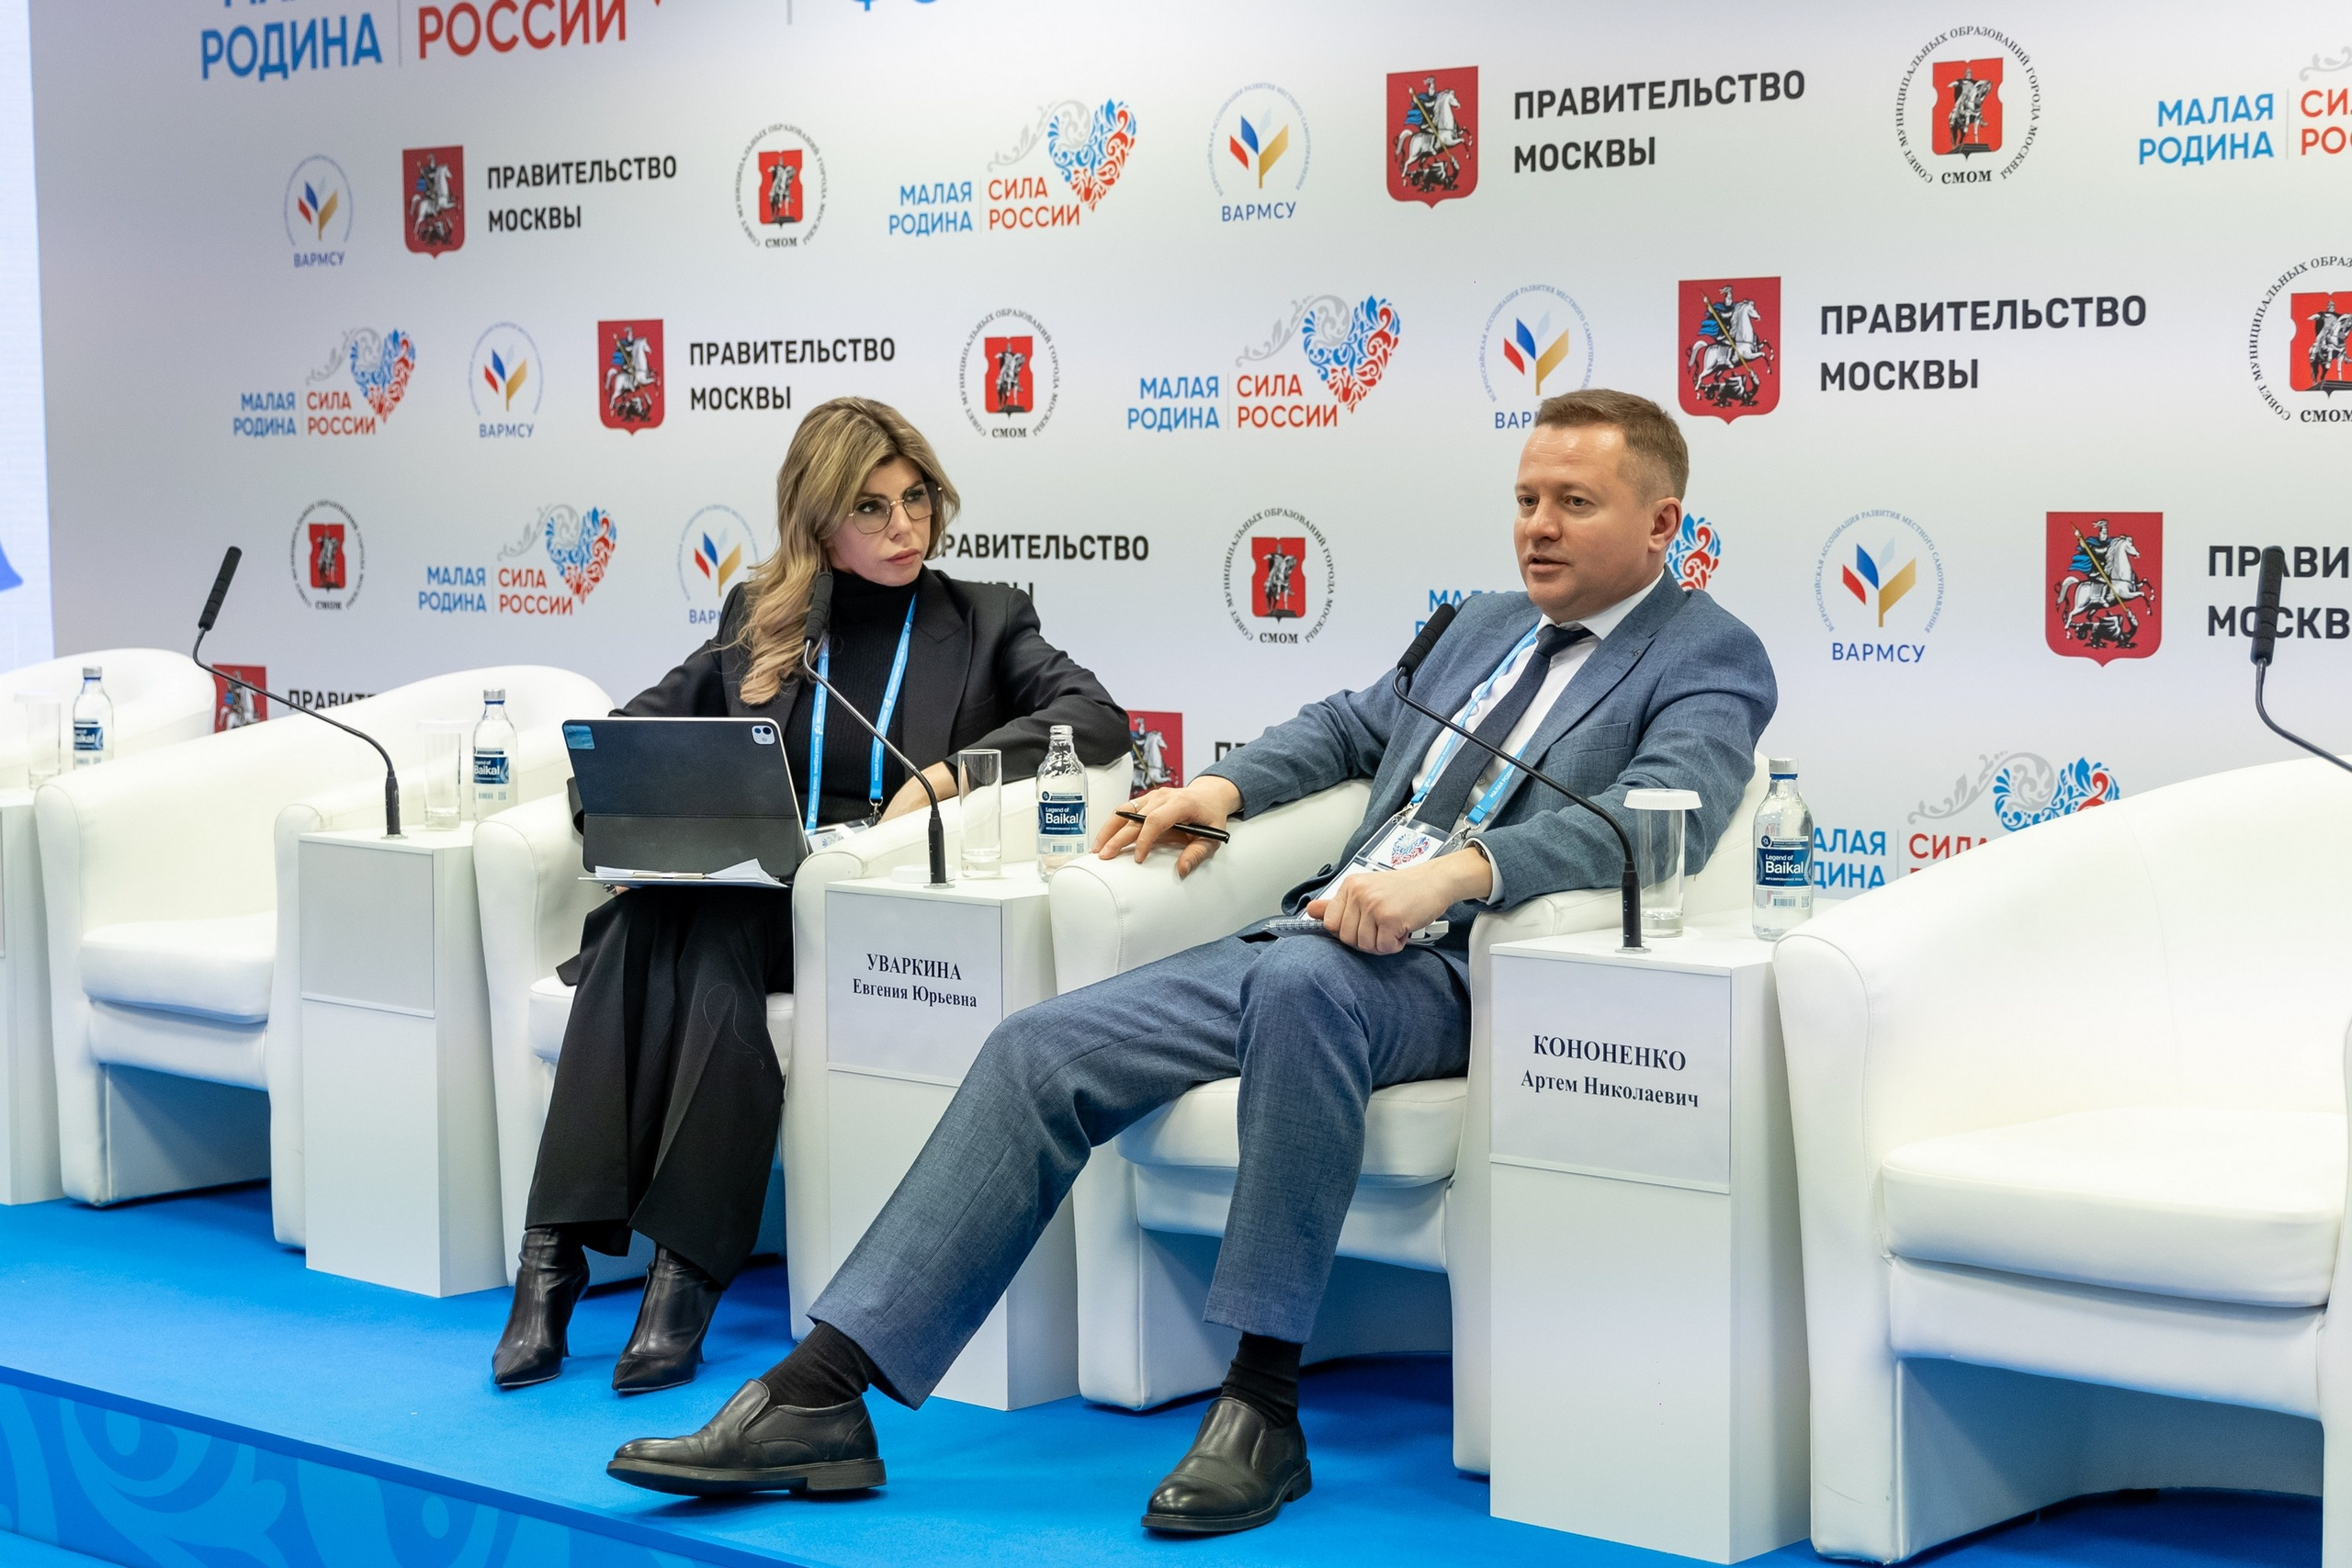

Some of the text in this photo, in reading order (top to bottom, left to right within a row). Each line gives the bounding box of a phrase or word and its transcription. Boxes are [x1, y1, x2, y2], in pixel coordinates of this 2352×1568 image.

[419, 0, 627, 59] РОССИИ
[201, 13, 383, 82] РОДИНА
[1514, 70, 1805, 119] ПРАВИТЕЛЬСТВО
[1896, 26, 2041, 184] СОВЕТ МУНИЦИПАЛЬНЫХ ОБРАЗОВАНИЙ ГОРОДА МОСКВЫ
[2301, 88, 2352, 118] СИ
[2158, 93, 2273, 127] МАЛАЯ
[2139, 130, 2275, 166] РОДИНА
[2301, 127, 2352, 156] РО
[1514, 136, 1656, 173] МОСКВЫ
[488, 155, 676, 189] ПРАВИТЕЛЬСТВО
[1941, 170, 1992, 184] СМОМ
[900, 181, 972, 206] МАЛАЯ
[989, 176, 1047, 200] СИЛА
[489, 205, 581, 233] МОСКВЫ
[889, 210, 973, 237] РОДИНА
[989, 204, 1080, 230] РОССИИ
[1222, 201, 1295, 222] ВАРМСУ
[765, 237, 797, 248] СМОМ
[294, 252, 345, 268] ВАРМСУ
[1821, 295, 2146, 334] ПРАВИТЕЛЬСТВО
[2249, 262, 2308, 382] МУНИЦИПАЛЬНЫХ
[690, 338, 895, 366] ПРАВИТЕЛЬСТВО
[1237, 375, 1303, 398] СИЛА
[1821, 358, 1978, 391] МОСКВЫ
[691, 386, 790, 410] МОСКВЫ
[1140, 375, 1219, 400] МАЛАЯ
[241, 391, 296, 412] МАЛАЯ
[307, 391, 351, 411] СИЛА
[2257, 384, 2291, 421] СОВЕТ
[233, 417, 296, 438] РОДИНА
[308, 415, 376, 435] РОССИИ
[1127, 406, 1220, 432] РОДИНА
[1238, 404, 1338, 428] РОССИИ
[1495, 412, 1538, 429] ВАР
[480, 423, 535, 438] ВАРМСУ
[992, 428, 1027, 437] СМОМ
[942, 534, 1148, 560] РАВИТЕЛЬСТВО
[427, 566, 486, 586] МАЛАЯ
[498, 568, 547, 588] СИЛА
[419, 592, 487, 614] РОДИНА
[500, 593, 573, 615] РОССИИ
[689, 609, 722, 625] ВАР
[1261, 632, 1298, 643] СМОМ
[1832, 642, 1926, 663] ВАРМСУ
[288, 690, 377, 710] ПРАВИ
[474, 764, 500, 775] Baikal
[1046, 813, 1079, 824] Baikal
[1814, 827, 1886, 856] АЛАЯ
[1766, 862, 1804, 874] Baikal
[1814, 860, 1885, 889] ДИНА
[867, 953, 961, 981] УВАРКИНА
[853, 978, 977, 1007] Евгения Юрьевна
[1533, 1034, 1686, 1071] КОНОНЕНКО
[1521, 1069, 1699, 1108] Артем Николаевич
